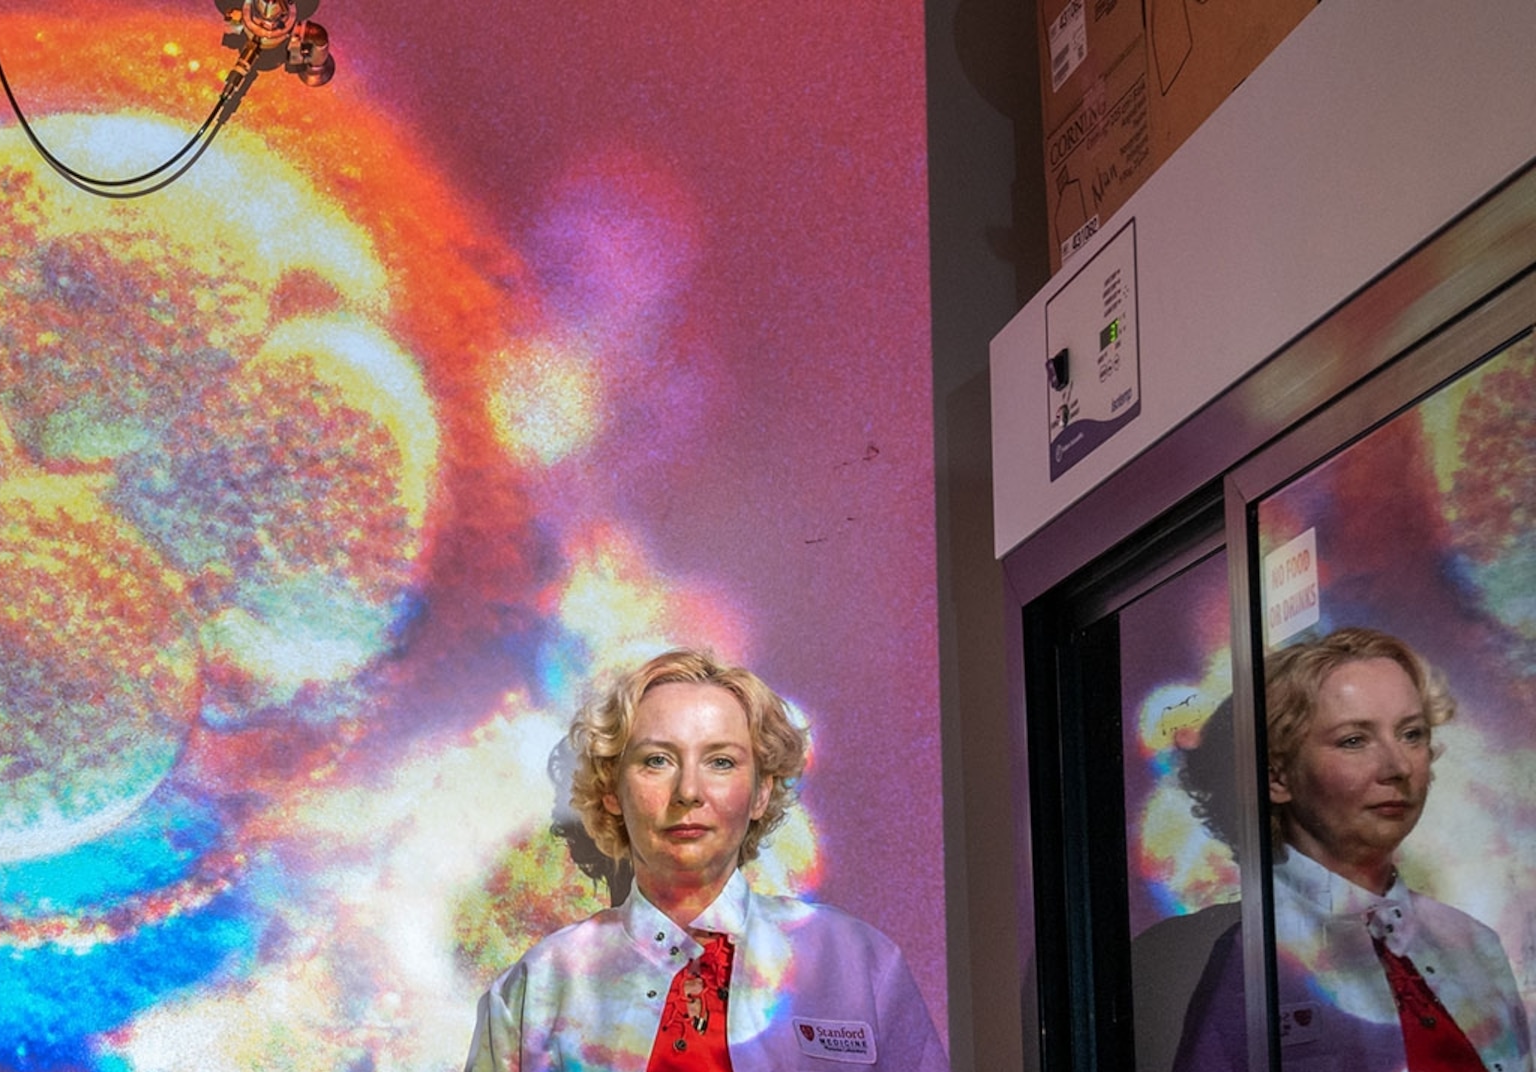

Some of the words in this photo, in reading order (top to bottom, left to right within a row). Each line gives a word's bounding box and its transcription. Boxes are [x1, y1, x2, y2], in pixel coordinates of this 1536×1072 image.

[1051, 99, 1106, 165] CORNING
[1286, 548, 1311, 582] FOOD
[1283, 582, 1317, 622] DRINKS
[816, 1026, 866, 1040] Stanford
[819, 1038, 868, 1049] MEDICINE
